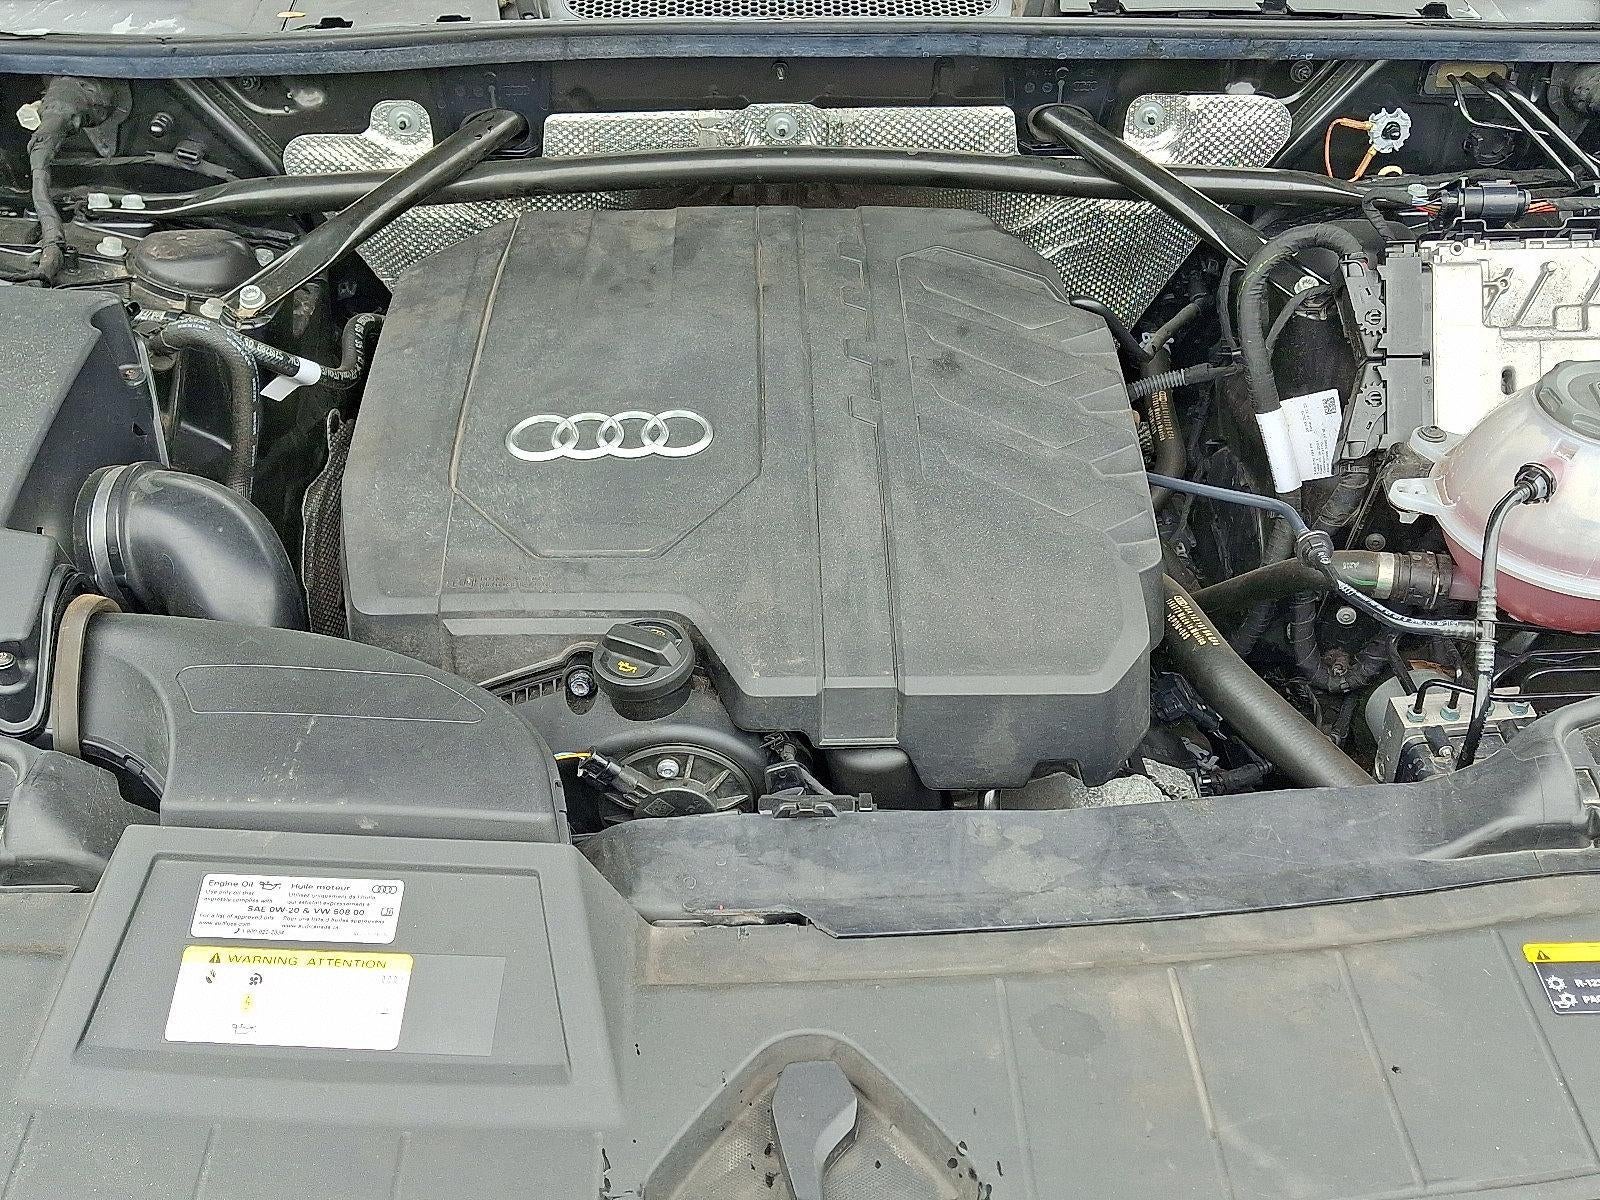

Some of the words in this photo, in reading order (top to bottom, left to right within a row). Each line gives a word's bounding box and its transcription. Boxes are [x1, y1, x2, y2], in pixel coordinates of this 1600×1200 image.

[208, 879, 239, 888] Engine
[241, 880, 254, 888] Oil
[247, 904, 266, 913] SAE
[333, 908, 351, 916] 508
[227, 953, 299, 966] WARNING
[306, 957, 388, 969] ATTENTION
